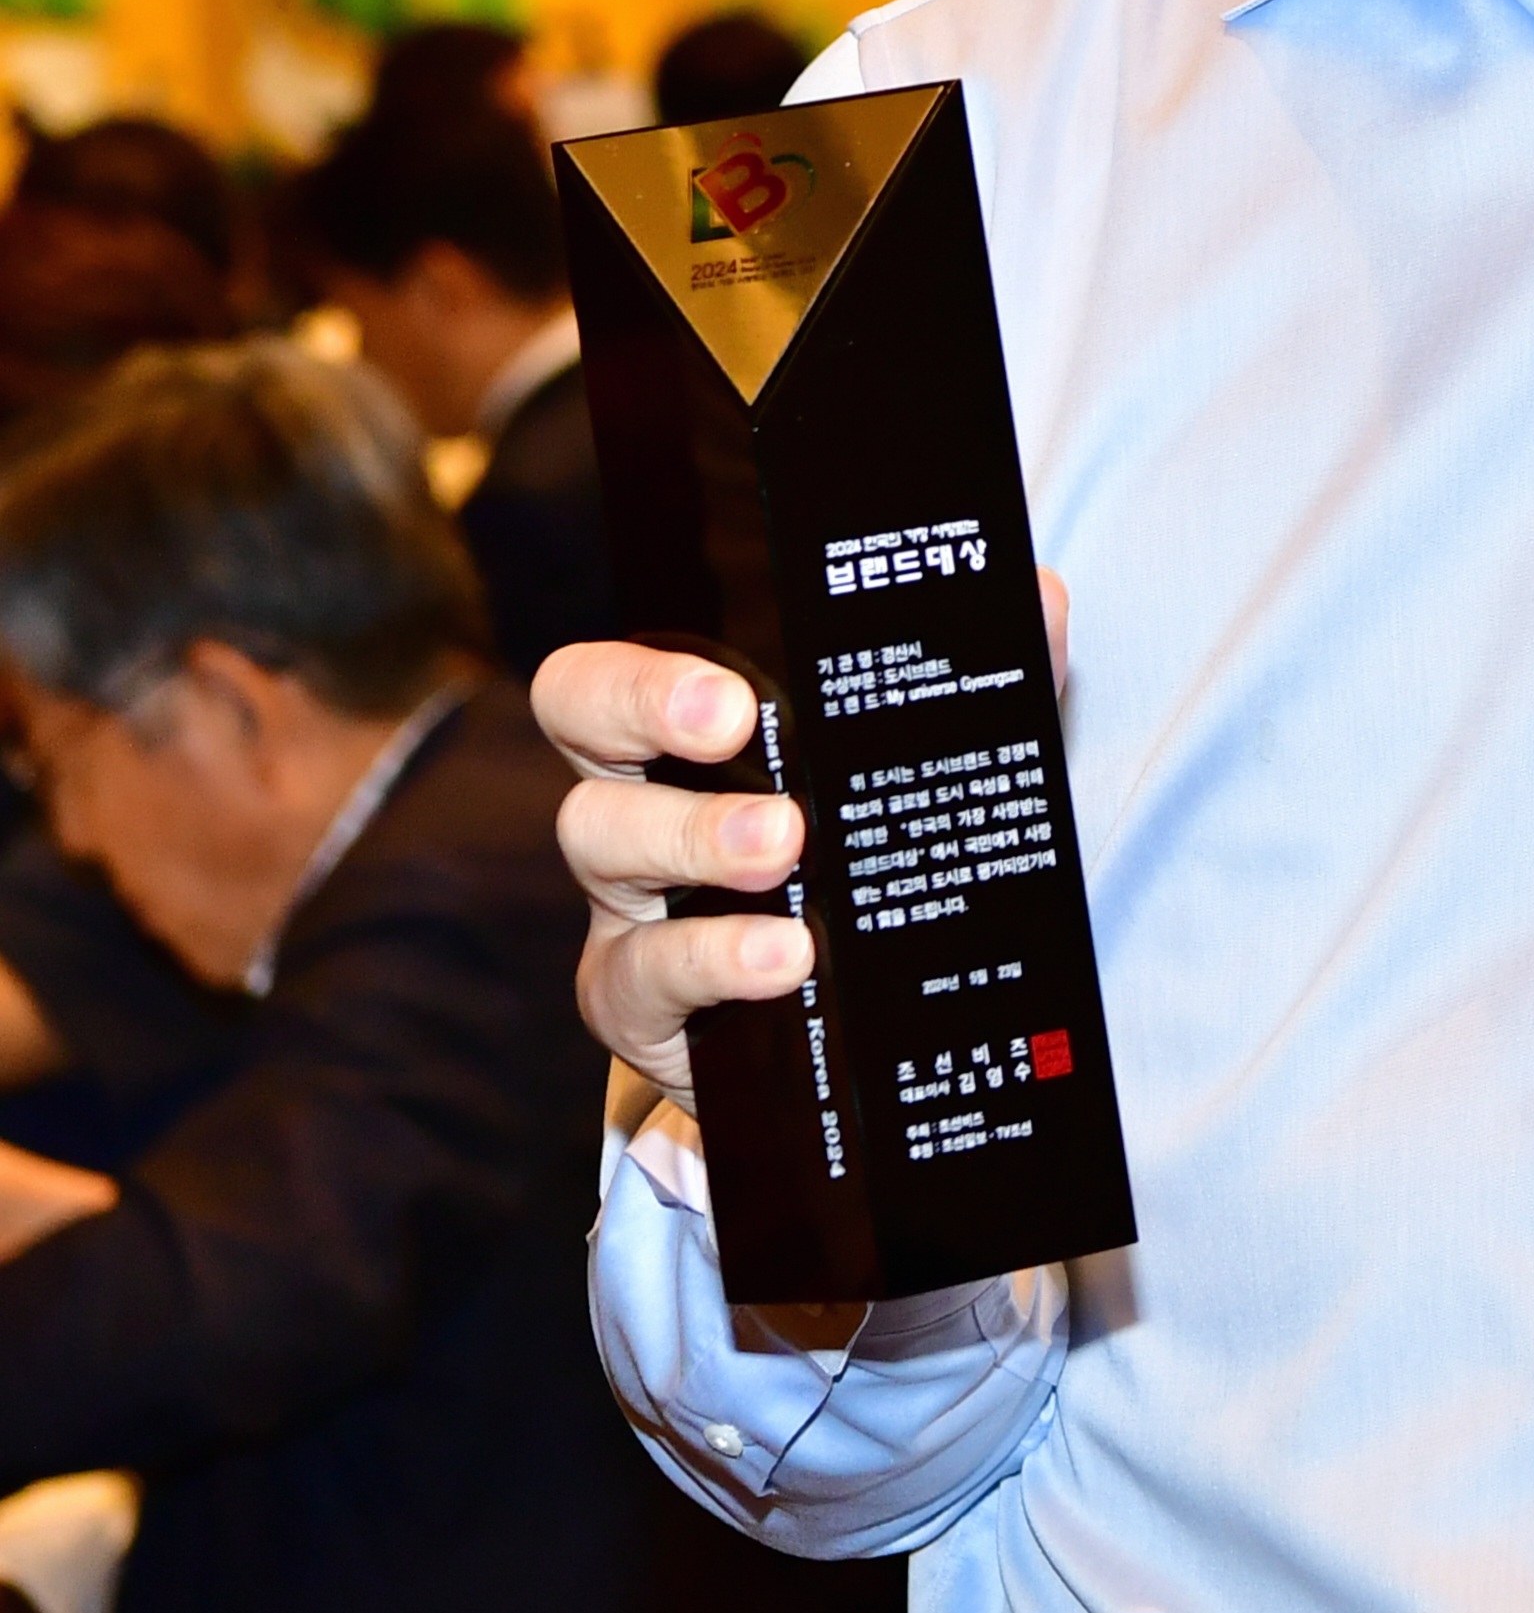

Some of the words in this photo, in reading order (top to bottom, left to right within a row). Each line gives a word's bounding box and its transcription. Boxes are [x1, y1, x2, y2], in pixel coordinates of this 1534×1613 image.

[691, 259, 738, 282] 2024
[825, 539, 862, 558] 2024
[826, 538, 987, 595] 브랜드대상
[908, 681, 958, 701] universe
[960, 669, 1024, 692] Gyeongsan
[872, 767, 914, 787] 도시는
[921, 751, 992, 777] 도시브랜드
[997, 740, 1039, 764] 경쟁력
[936, 783, 964, 803] 도시
[957, 806, 985, 826] 가장
[992, 797, 1047, 820] 사랑받는
[964, 828, 1019, 853] 국민에게
[1024, 822, 1051, 842] 사랑
[931, 866, 973, 889] 도시로
[900, 1080, 950, 1103] 대표이사
[820, 1110, 846, 1179] 2024
